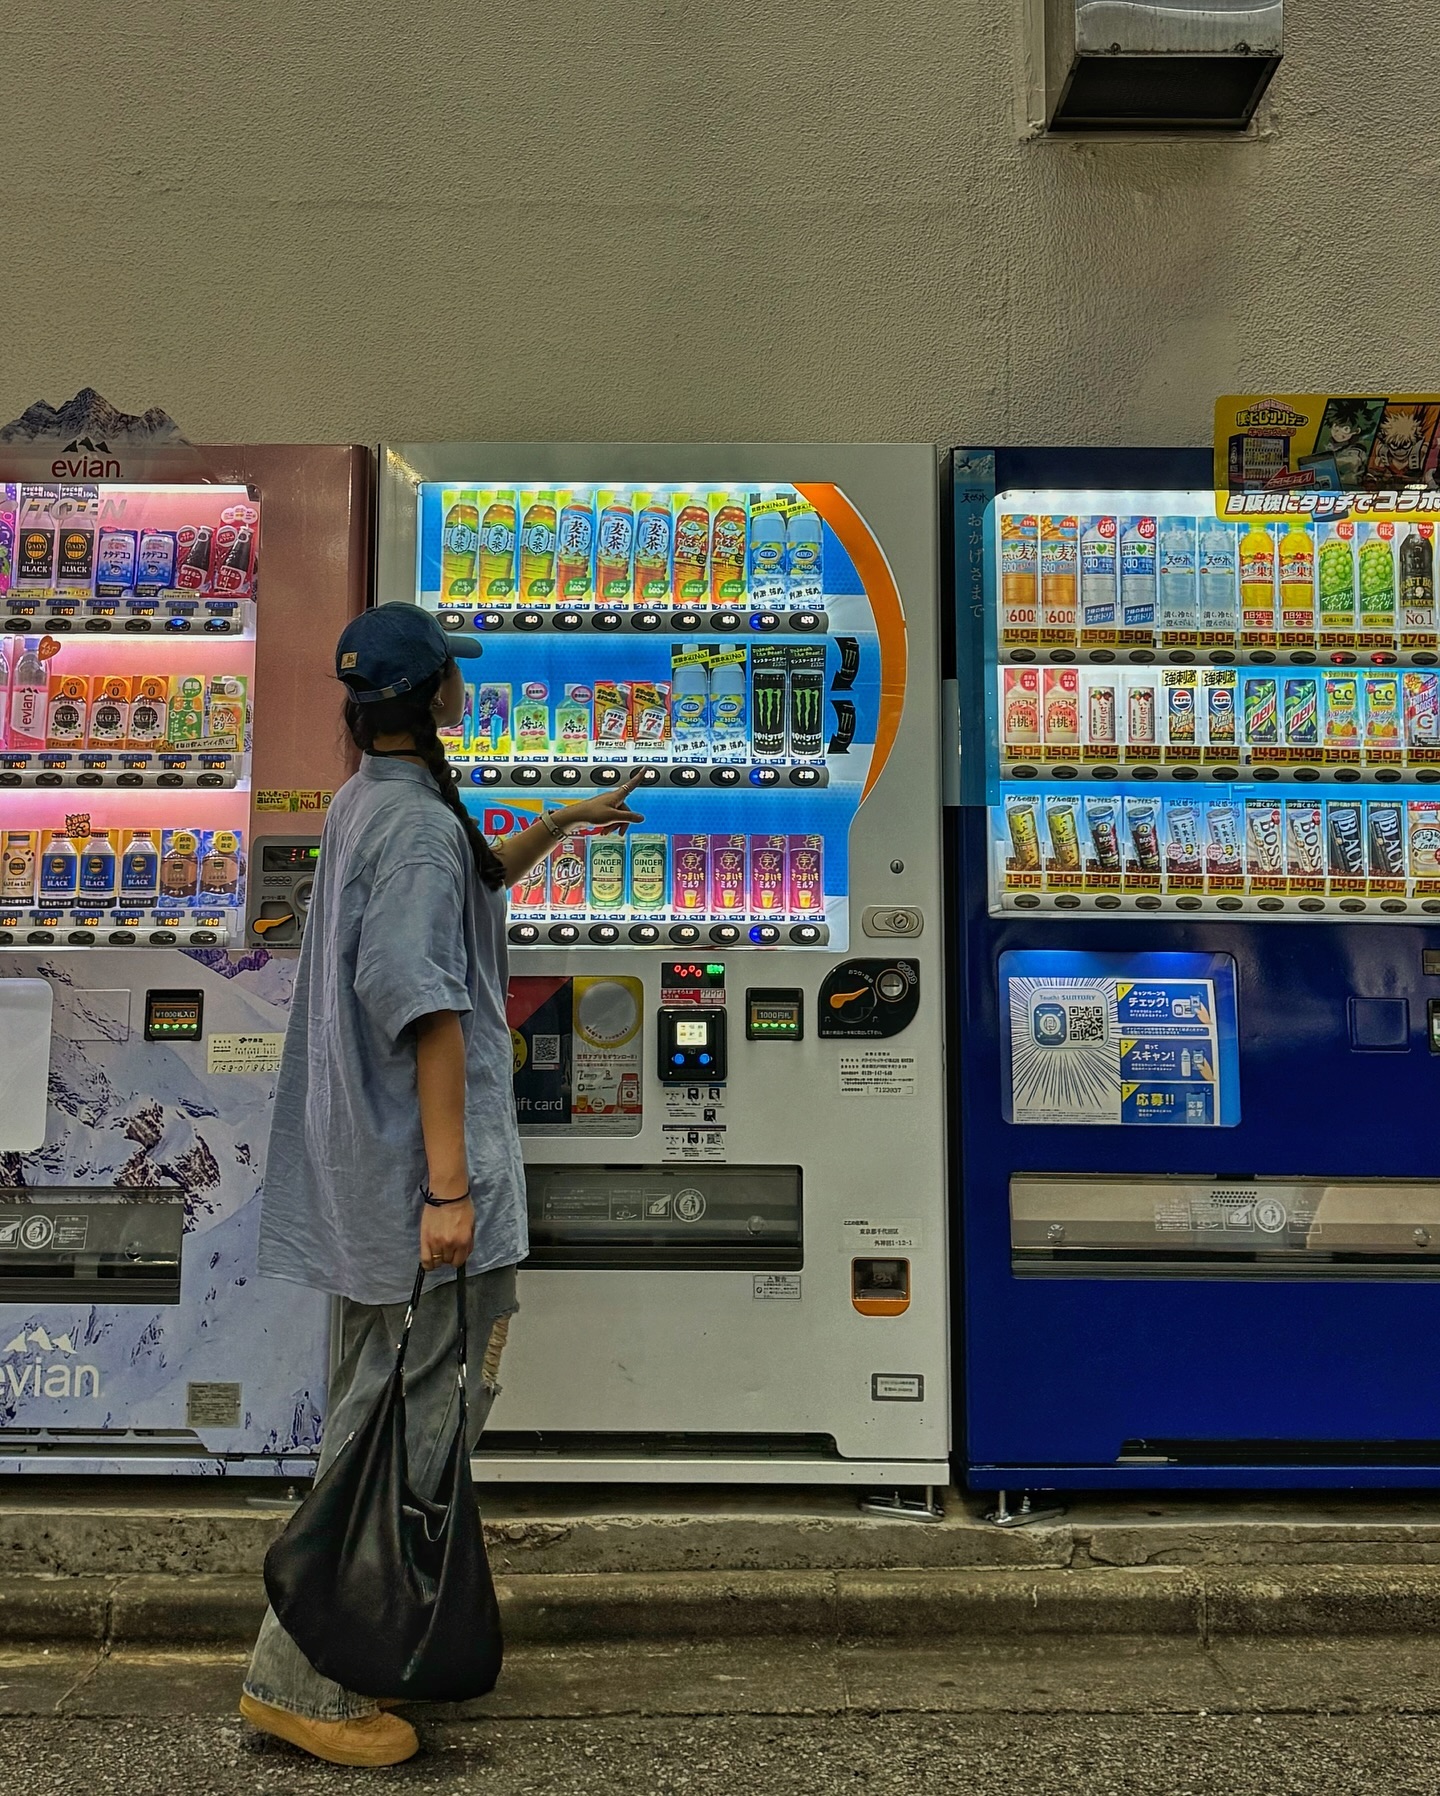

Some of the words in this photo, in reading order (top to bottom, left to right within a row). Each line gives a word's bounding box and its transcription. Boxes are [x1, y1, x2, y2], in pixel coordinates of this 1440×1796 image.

[1099, 523, 1115, 533] 600
[1139, 524, 1155, 533] 600
[566, 520, 583, 548] 麦茶
[607, 521, 625, 550] 麦茶
[644, 522, 663, 551] 麦茶
[103, 551, 131, 560] ナタデココ
[142, 551, 169, 560] ナタデココ
[1165, 555, 1191, 566] 天然水
[1205, 555, 1232, 566] 天然水
[22, 565, 47, 573] BLACK
[967, 513, 986, 618] おかげさまで
[1009, 609, 1035, 623] 600
[1048, 610, 1074, 624] 600
[1406, 610, 1434, 625] NO.1
[1003, 629, 1039, 639] 140円
[1040, 630, 1076, 640] 140円
[1083, 630, 1116, 640] 150円
[1119, 630, 1153, 640] 150円
[1163, 632, 1198, 642] 130円
[1200, 632, 1234, 642] 130円
[1242, 633, 1277, 643] 160円
[1280, 633, 1314, 643] 160円
[1320, 633, 1355, 644] 150円
[1358, 633, 1393, 644] 150円
[1402, 634, 1437, 644] 170円
[1164, 669, 1198, 687] 強刺激
[1204, 669, 1237, 687] 強刺激
[22, 695, 33, 725] evian
[607, 718, 618, 731] 7
[645, 718, 657, 731] 7
[1099, 701, 1109, 737] いちごミルク
[1139, 702, 1148, 738] いちごミルク
[1007, 745, 1040, 756] 150円
[1046, 745, 1080, 756] 150円
[1085, 745, 1119, 755] 140円
[1126, 746, 1160, 756] 140円
[1165, 746, 1200, 757] 140円
[1204, 746, 1240, 757] 140円
[1252, 747, 1287, 758] 140円
[1288, 748, 1323, 758] 140円
[1325, 749, 1360, 760] 130円
[1366, 749, 1402, 760] 130円
[1260, 820, 1282, 868] BOSS
[1300, 820, 1322, 869] BOSS
[1338, 818, 1363, 873] BLACK
[1378, 818, 1404, 874] BLACK
[593, 858, 623, 866] GINGER
[634, 858, 663, 867] GINGER
[554, 860, 582, 880] Cola
[599, 866, 615, 874] ALE
[641, 866, 656, 874] ALE
[676, 872, 705, 882] さつまいも
[715, 872, 743, 882] さつまいも
[753, 872, 782, 882] さつまいも
[791, 872, 819, 882] さつまいも
[1007, 874, 1041, 885] 130円
[1048, 874, 1083, 884] 130円
[1085, 874, 1121, 885] 130円
[1124, 875, 1160, 885] 130円
[1168, 875, 1204, 886] 130円
[1209, 876, 1245, 886] 130円
[1253, 876, 1287, 887] 140円
[1291, 877, 1325, 888] 140円
[682, 881, 700, 889] ミルク
[720, 881, 738, 889] ミルク
[758, 881, 777, 889] ミルク
[796, 881, 814, 889] ミルク
[1331, 878, 1367, 889] 140円
[1372, 879, 1405, 889] 140円
[1128, 997, 1170, 1008] チェック!
[1131, 1051, 1175, 1061] スキャン!
[516, 1097, 532, 1111] ift
[534, 1097, 563, 1111] card
[1136, 1093, 1175, 1106] 応募!!
